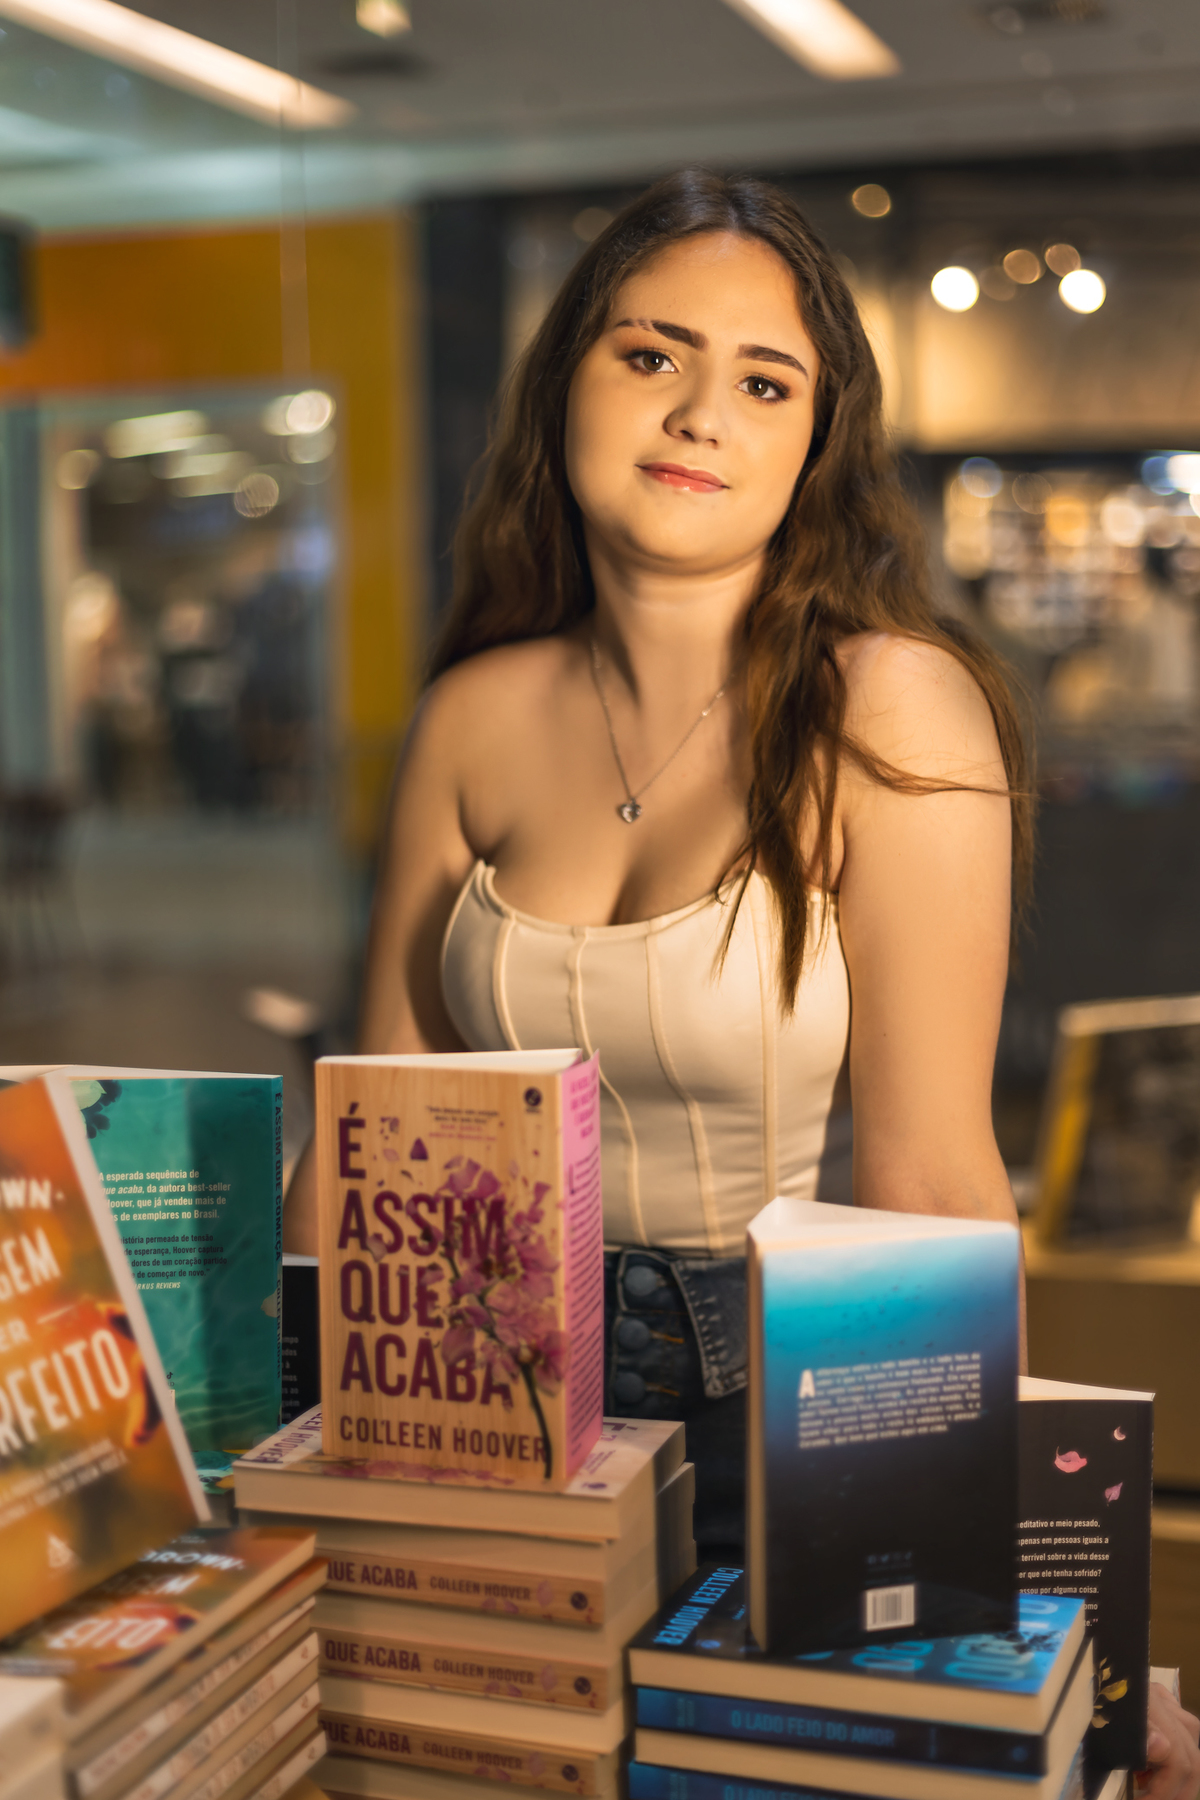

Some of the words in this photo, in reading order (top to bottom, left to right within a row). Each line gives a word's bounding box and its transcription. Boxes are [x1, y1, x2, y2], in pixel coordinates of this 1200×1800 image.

[338, 1102, 367, 1180] É
[106, 1171, 144, 1182] esperada
[146, 1170, 188, 1181] sequência
[190, 1170, 200, 1179] de
[118, 1184, 144, 1195] acaba,
[146, 1184, 156, 1193] da
[158, 1183, 186, 1193] autora
[188, 1182, 231, 1193] best-seller
[136, 1200, 152, 1208] que
[154, 1197, 162, 1208] já
[164, 1197, 193, 1206] vendeu
[195, 1196, 214, 1206] mais
[216, 1196, 226, 1205] de
[120, 1212, 130, 1221] de
[132, 1210, 180, 1222] exemplares
[182, 1211, 192, 1220] no
[194, 1209, 220, 1220] Brasil.
[338, 1188, 507, 1262] ASSIM
[146, 1235, 180, 1246] permeada
[180, 1234, 190, 1243] de
[191, 1234, 214, 1242] tensão
[134, 1246, 172, 1257] esperança,
[172, 1246, 196, 1254] Hoover
[198, 1245, 224, 1254] captura
[132, 1258, 150, 1268] dores
[152, 1258, 160, 1267] de
[174, 1256, 202, 1268] coração
[203, 1256, 228, 1267] partido
[136, 1270, 146, 1279] de
[147, 1269, 176, 1280] começar
[178, 1268, 187, 1278] de
[156, 1281, 181, 1290] REVIEWS
[340, 1259, 445, 1330] QUE
[340, 1331, 514, 1409] ACABA
[340, 1415, 443, 1451] COLLEEN
[453, 1427, 547, 1463] HOOVER
[1056, 1519, 1072, 1528] meio
[1074, 1519, 1100, 1528] pesado.
[1042, 1537, 1052, 1545] em
[1054, 1536, 1080, 1546] pessoas
[1082, 1536, 1102, 1546] iguais
[1047, 1552, 1066, 1561] sobre
[1074, 1552, 1088, 1560] vida
[1089, 1552, 1110, 1560] desse
[1028, 1570, 1040, 1579] que
[1042, 1570, 1052, 1578] ele
[1054, 1569, 1072, 1578] tenha
[1074, 1568, 1102, 1578] sofrido?
[361, 1564, 418, 1590] ACABA
[430, 1576, 480, 1596] COLLEEN
[484, 1582, 530, 1601] HOOVER
[688, 1566, 744, 1605] COLLEEN
[1052, 1586, 1078, 1595] alguma
[1078, 1586, 1100, 1594] coisa.
[652, 1606, 710, 1646] HOOVER
[325, 1639, 360, 1664] QUE
[364, 1646, 422, 1672] ACABA
[434, 1658, 484, 1678] COLLEEN
[488, 1666, 534, 1686] HOOVER
[731, 1710, 742, 1729] O
[745, 1712, 784, 1734] LADO
[788, 1716, 822, 1739] FEIO
[826, 1722, 848, 1742] DO
[851, 1725, 895, 1747] AMOR
[355, 1726, 411, 1754] ACABA
[423, 1741, 473, 1763] COLLEEN
[476, 1751, 523, 1771] HOOVER
